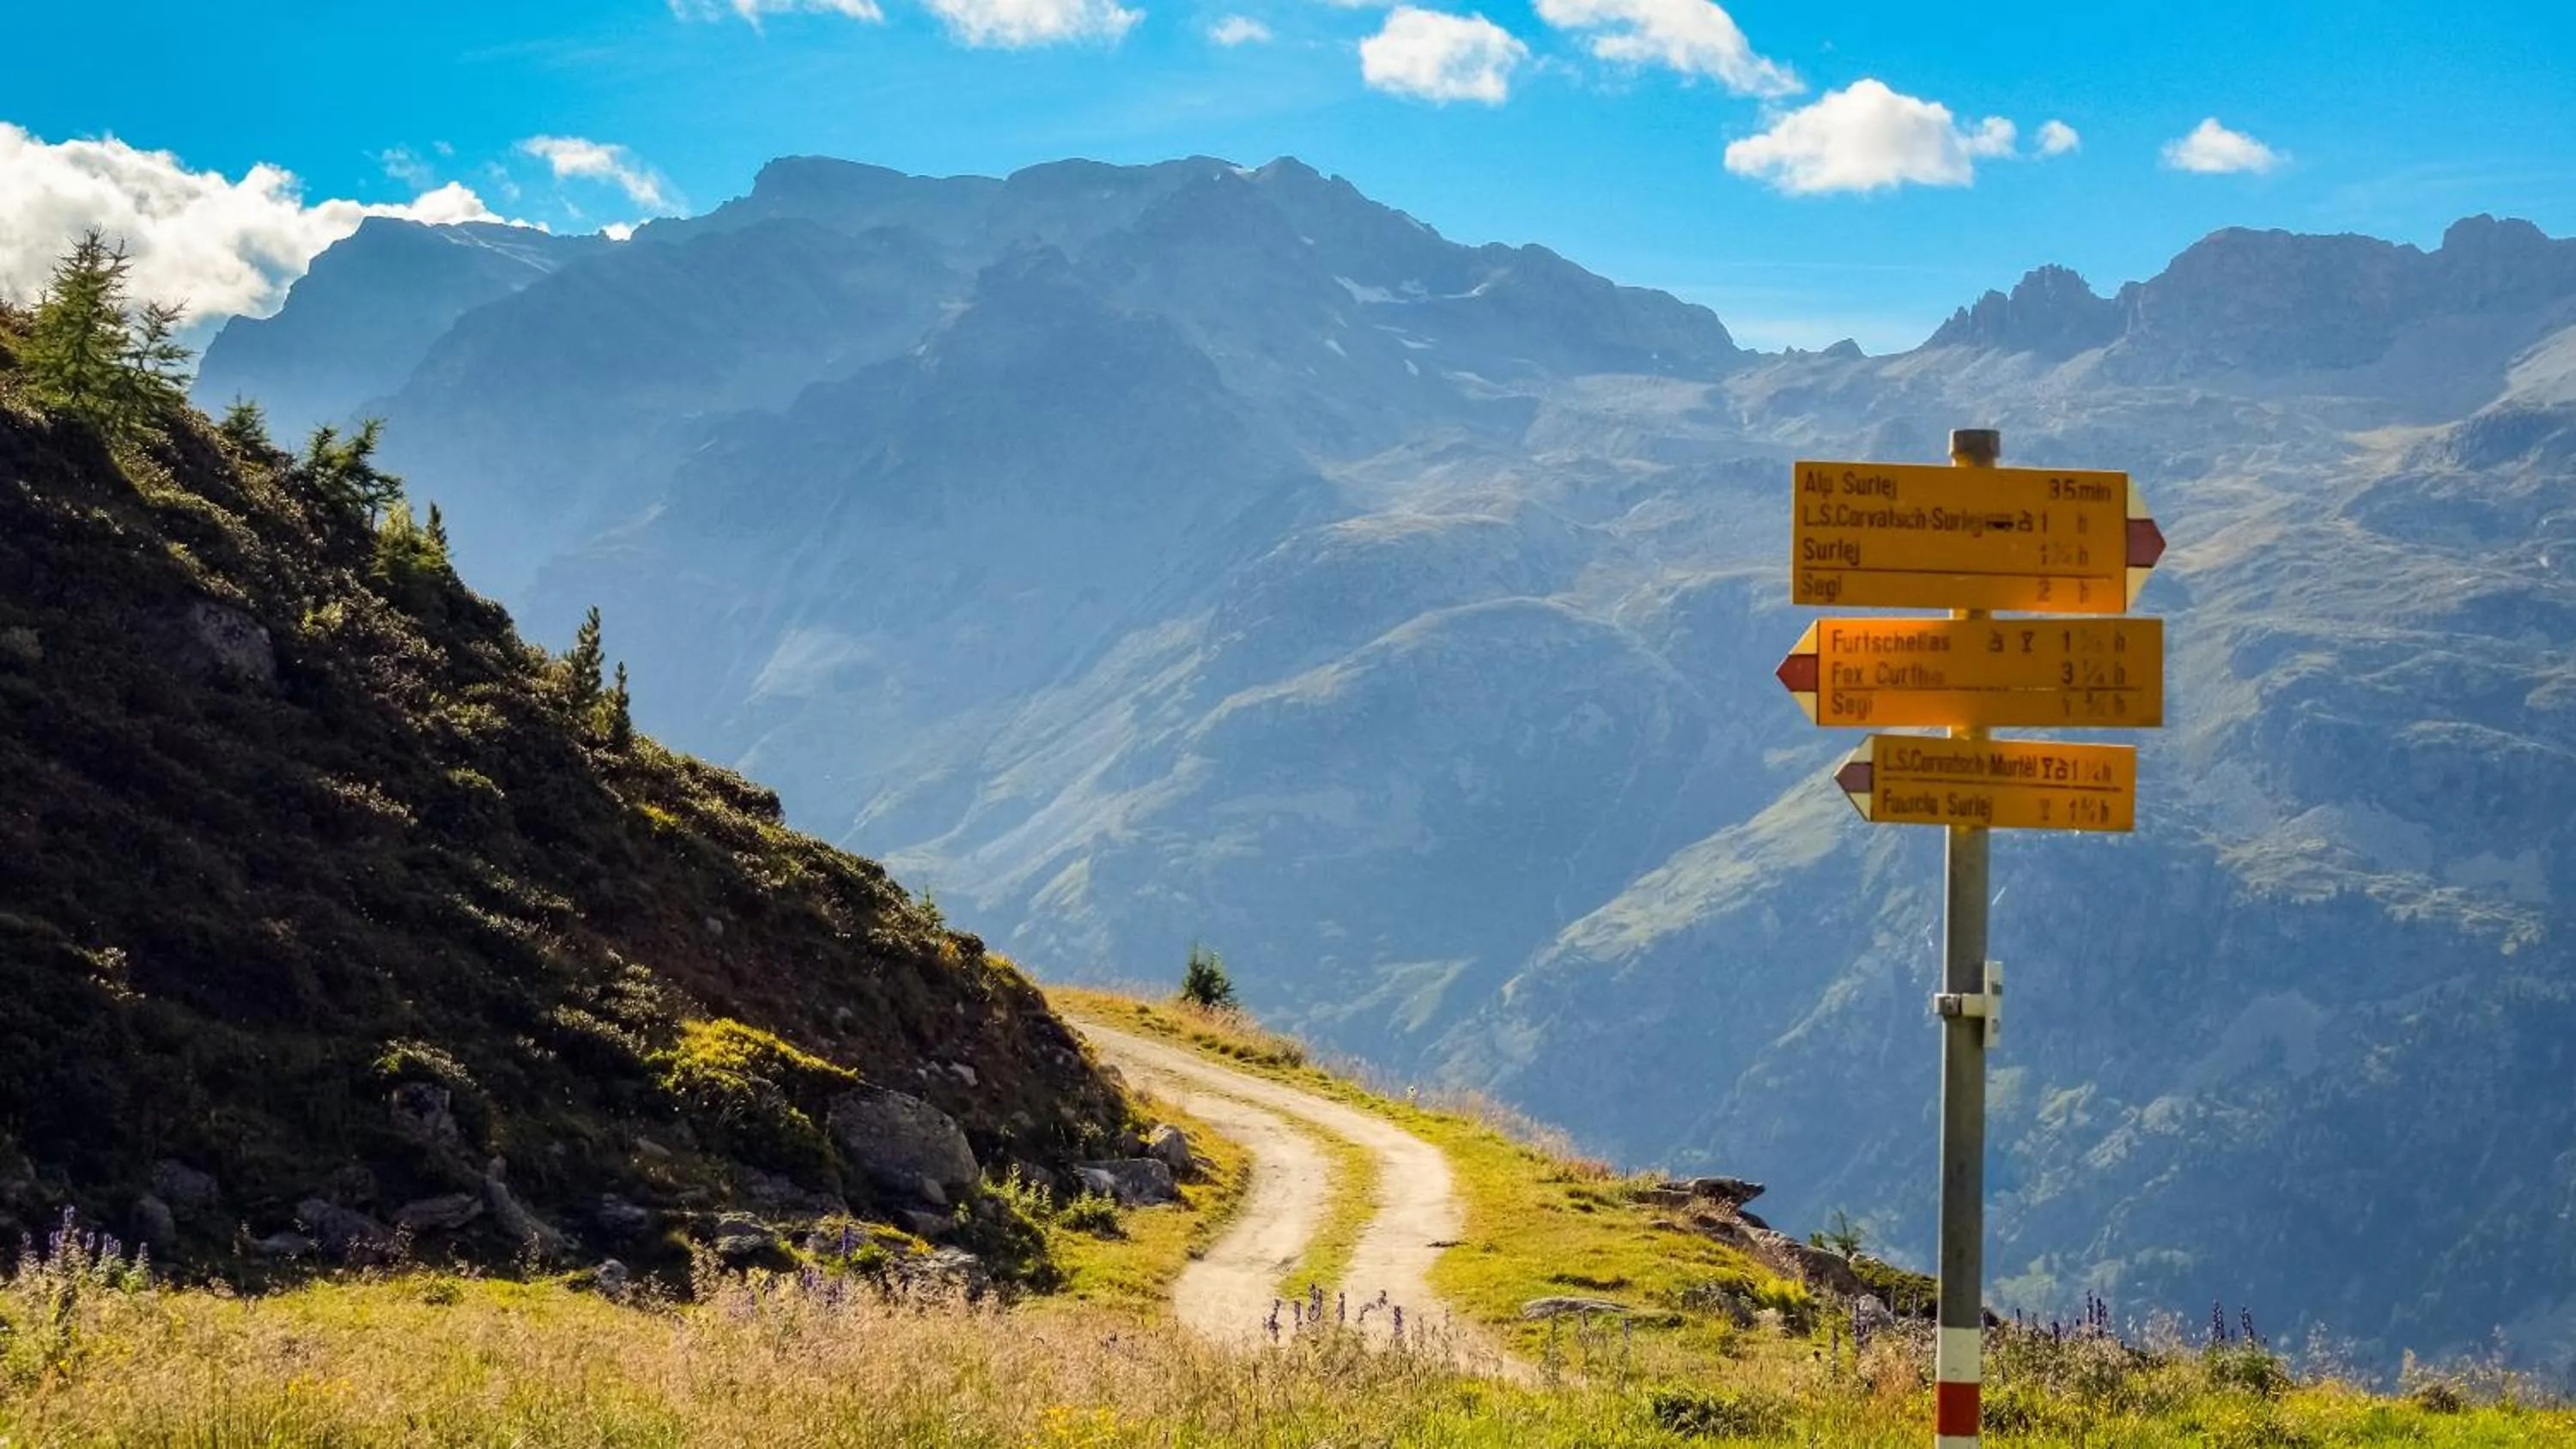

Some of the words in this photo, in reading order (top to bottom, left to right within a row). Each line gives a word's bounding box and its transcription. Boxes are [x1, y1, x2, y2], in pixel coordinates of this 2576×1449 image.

[1804, 470, 1833, 500] Alp
[1843, 471, 1898, 500] Surlej
[1803, 537, 1861, 567] Surlej
[1832, 629, 1951, 653] Furtschellas
[1947, 791, 1993, 824] Surlej
